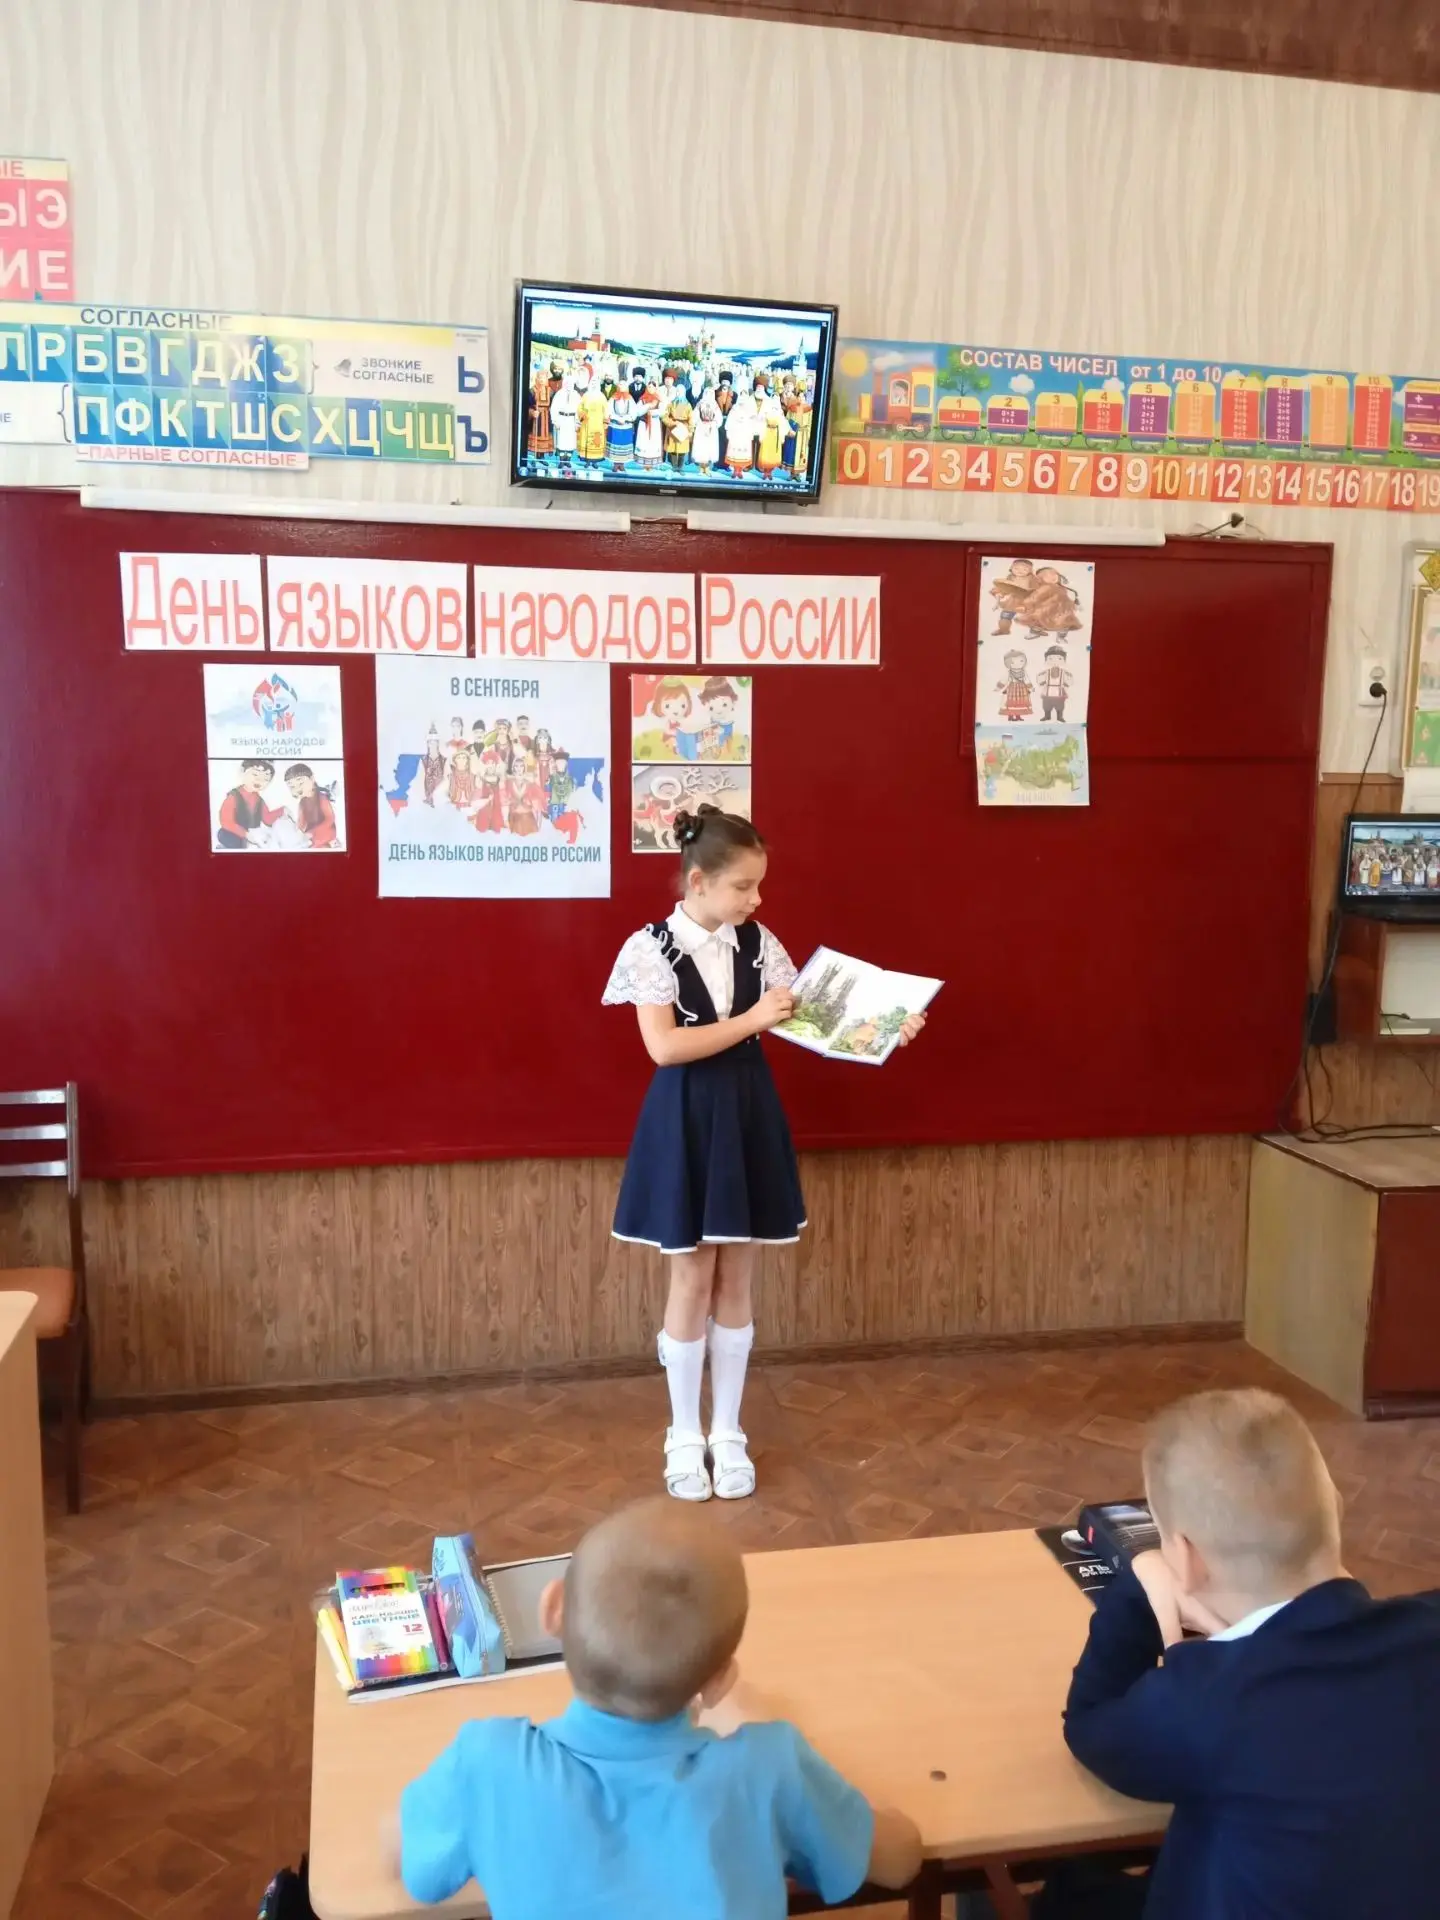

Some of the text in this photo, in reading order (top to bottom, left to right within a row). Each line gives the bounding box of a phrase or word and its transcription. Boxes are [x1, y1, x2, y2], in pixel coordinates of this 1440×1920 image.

[80, 307, 232, 332] СОГЛАСНЫЕ
[361, 357, 422, 371] ЗВОНКИЕ
[457, 355, 486, 394] Ь
[960, 349, 1222, 383] СОСТАВ ЧИСЕЛ от 1 до 10
[352, 369, 435, 385] СОГЛАСНЫЕ
[1004, 397, 1013, 408] 2
[1053, 394, 1060, 404] 3
[1100, 391, 1108, 402] 4
[1145, 384, 1153, 394] 5
[1239, 378, 1246, 389] 7
[457, 415, 488, 453] Ъ
[89, 446, 297, 467] ПАРНЫЕ СОГЛАСНЫЕ
[843, 443, 1440, 507] 0 1 2 3 4 5 6 7 8 9 10 11 12 13 14 15 16 17 18 19
[126, 556, 877, 661] День языков народов России
[464, 677, 540, 699] СЕНТЯБРЯ
[230, 737, 326, 746] ЯЗЫКИ НАРОДОВ
[256, 747, 302, 756] РОССИИ
[388, 842, 602, 864] ДЕНЬ ЯЗЫКОВ НАРОДОВ РОССИИ
[402, 1623, 424, 1633] 12
